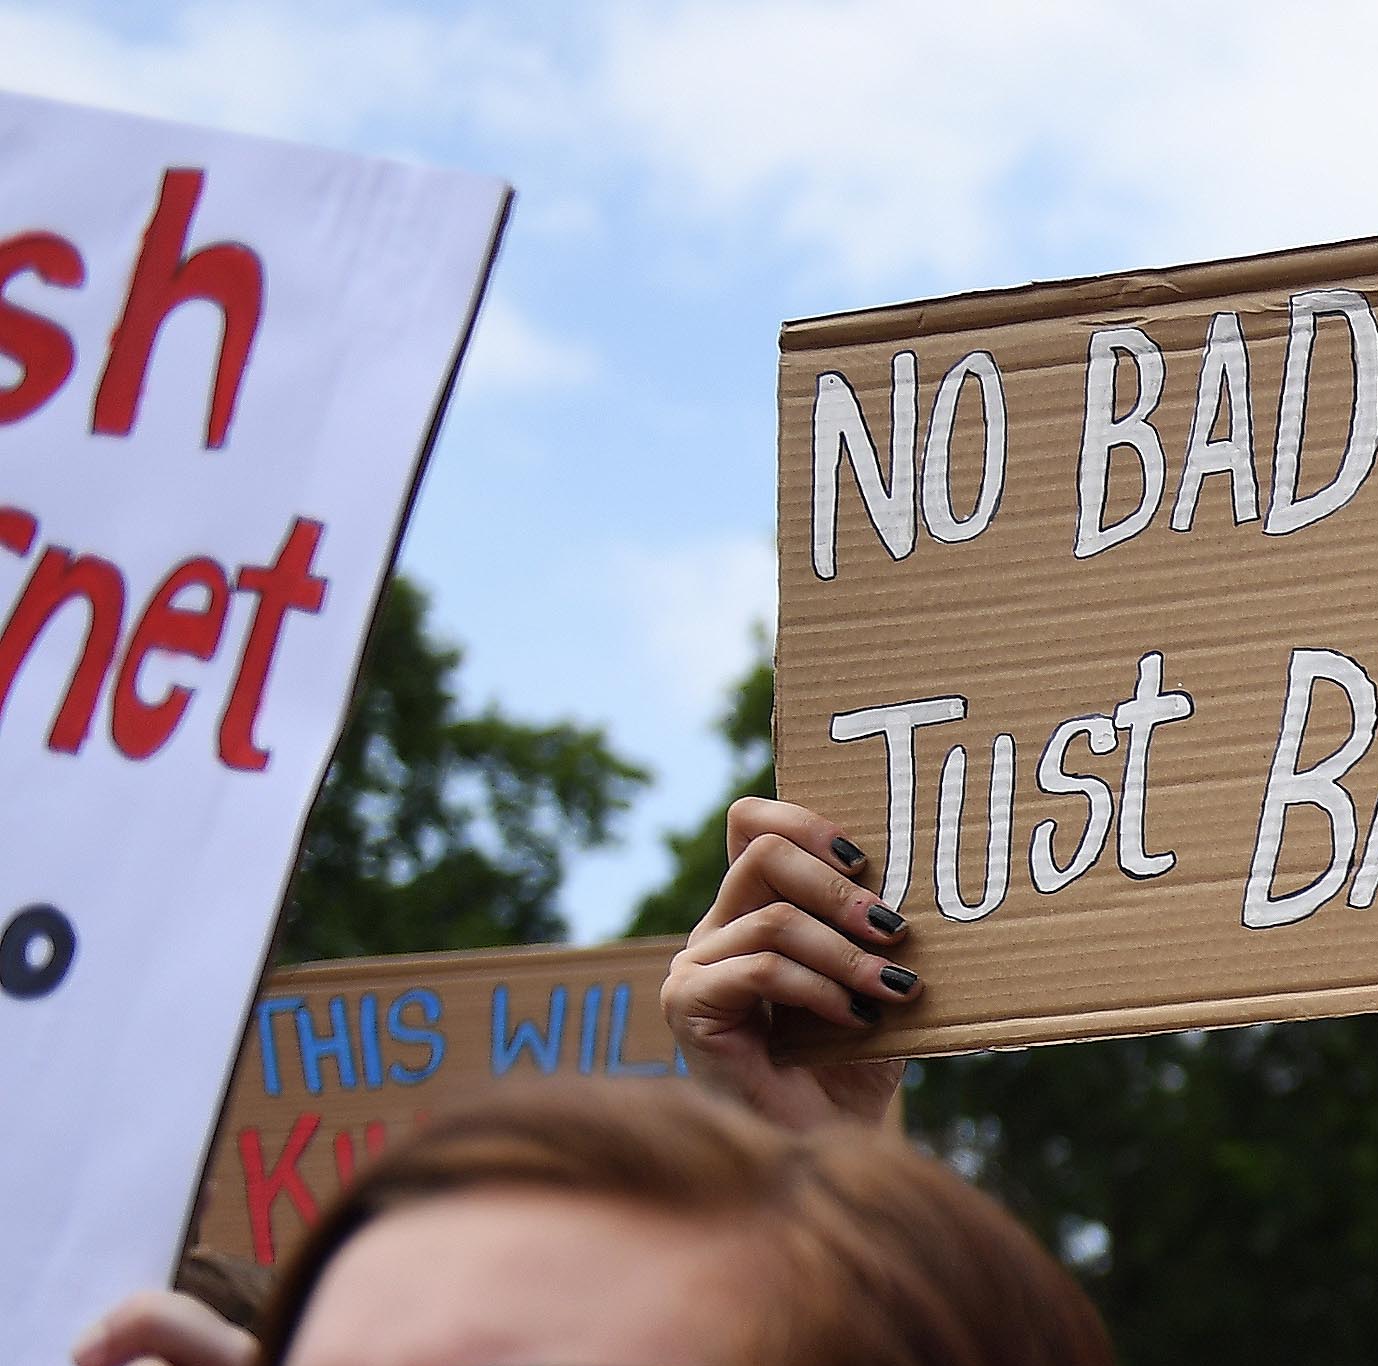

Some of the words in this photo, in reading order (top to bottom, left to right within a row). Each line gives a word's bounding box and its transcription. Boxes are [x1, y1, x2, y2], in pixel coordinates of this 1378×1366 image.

[812, 349, 1008, 581] NO
[255, 986, 446, 1097] THIS
[490, 983, 690, 1078] WIL
